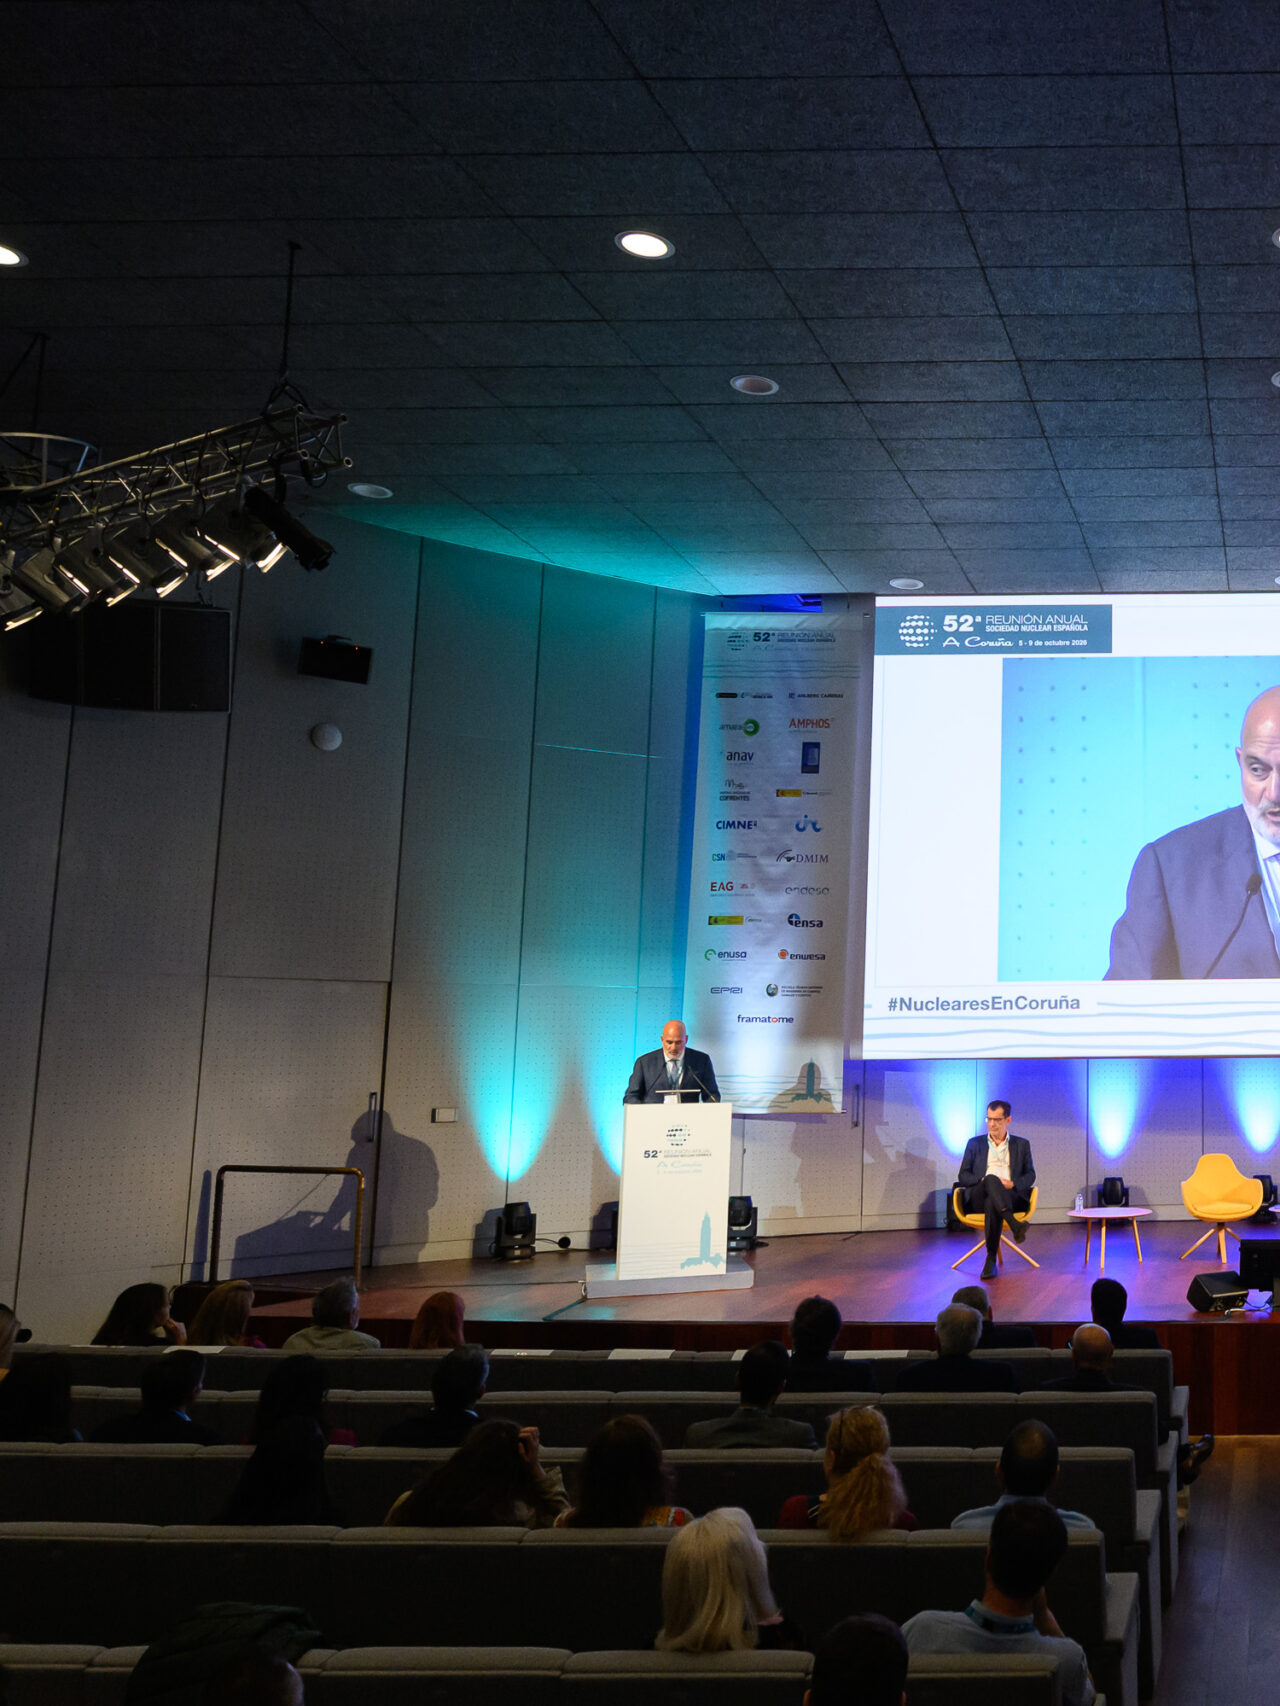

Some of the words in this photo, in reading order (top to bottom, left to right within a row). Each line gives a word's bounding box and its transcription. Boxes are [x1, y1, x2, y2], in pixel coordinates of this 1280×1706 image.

[942, 614, 982, 632] 52ª
[985, 613, 1042, 625] REUNIÓN
[1045, 614, 1089, 625] ANUAL
[985, 624, 1019, 632] SOCIEDAD
[1021, 624, 1052, 632] NUCLEAR
[1053, 622, 1089, 632] ESPAÑOLA
[965, 636, 1014, 647] Coruña
[1044, 638, 1071, 646] octubre
[788, 718, 830, 729] AMPHOS
[726, 751, 754, 761] anav
[716, 820, 753, 830] CIMNE
[796, 854, 829, 863] DMIM
[710, 881, 734, 892] EAG
[794, 919, 823, 928] ensa
[717, 951, 747, 959] enusa
[888, 995, 1080, 1012] #NuclearesEnCoruña
[737, 1014, 794, 1024] framatome
